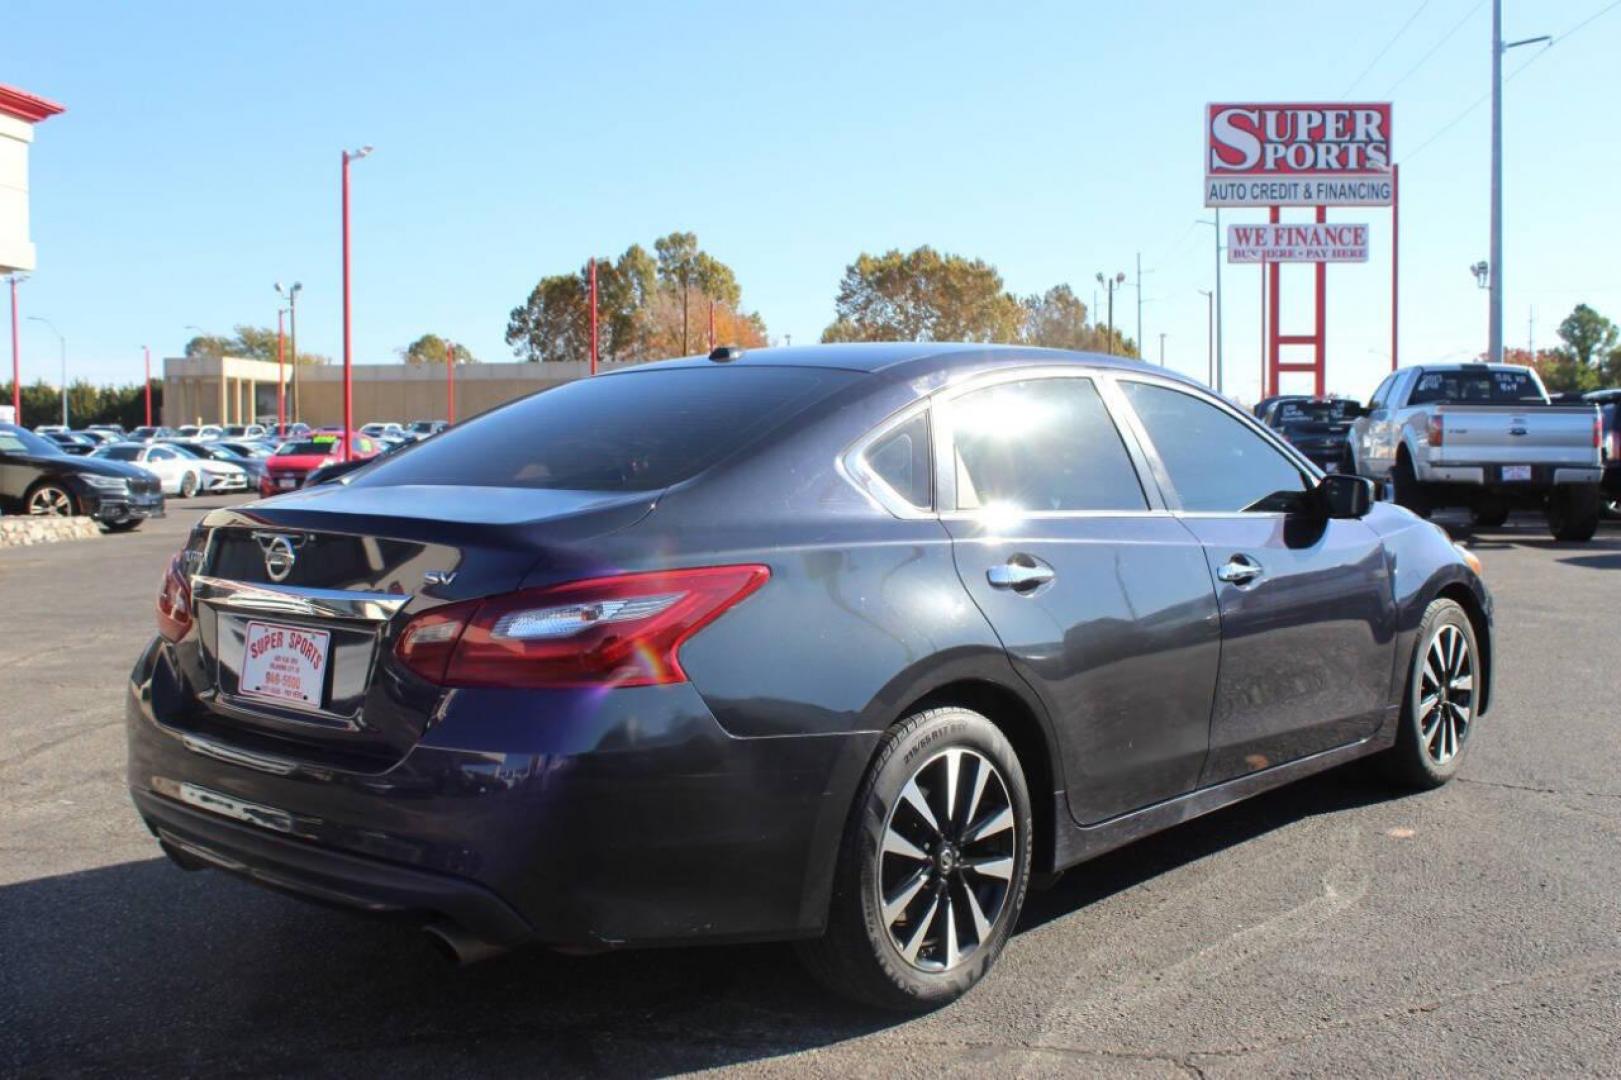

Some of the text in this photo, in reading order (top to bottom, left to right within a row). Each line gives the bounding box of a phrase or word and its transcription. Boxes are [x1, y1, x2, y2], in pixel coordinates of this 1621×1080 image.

[1209, 182, 1391, 200] AUTO CREDIT & FINANCING
[1234, 226, 1366, 247] WE FINANCE
[1306, 248, 1328, 259] PAY
[1332, 248, 1367, 258] HERE
[423, 572, 457, 585] SV
[250, 631, 322, 671] SUPER SPORTS
